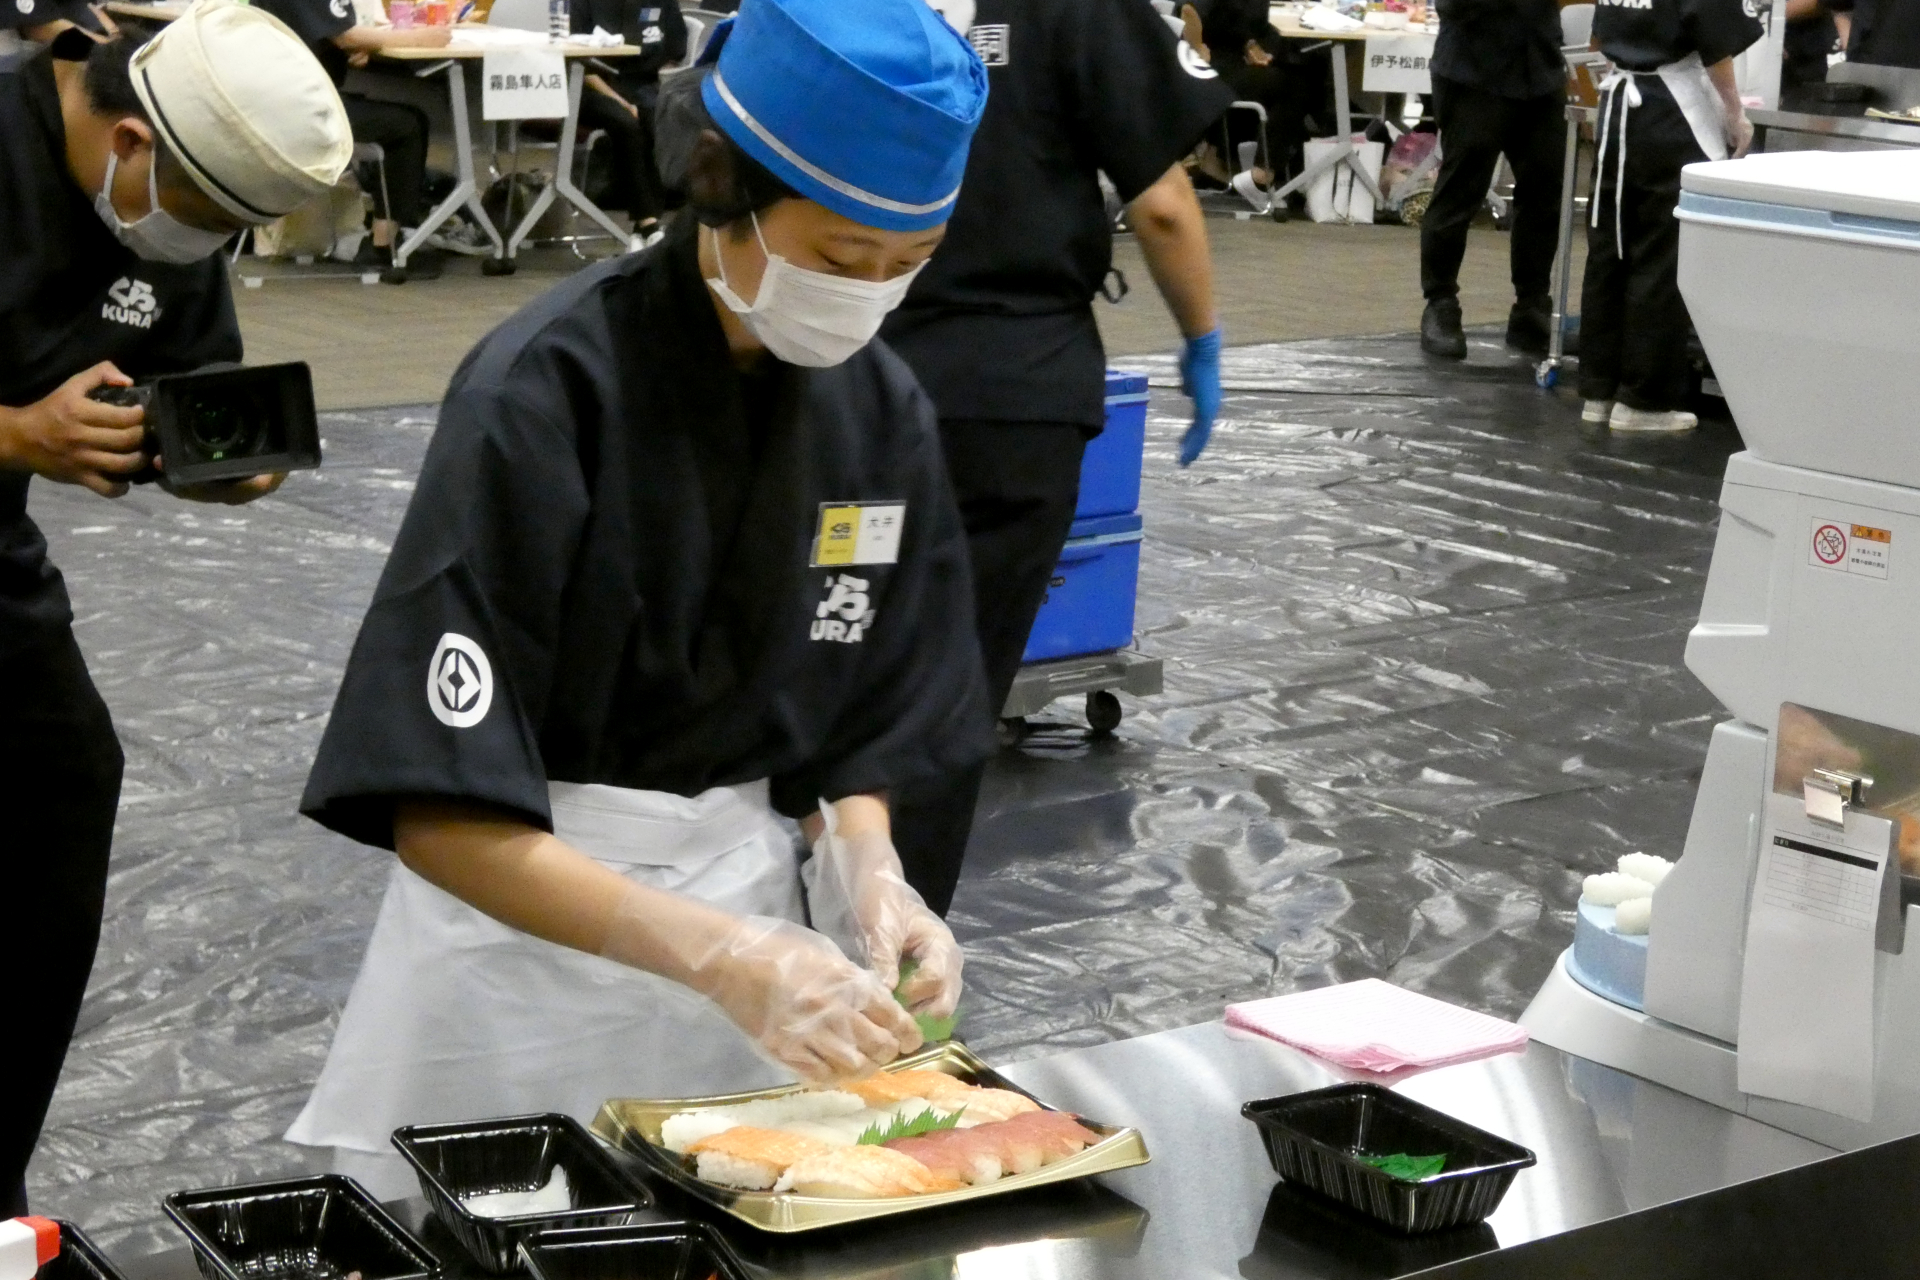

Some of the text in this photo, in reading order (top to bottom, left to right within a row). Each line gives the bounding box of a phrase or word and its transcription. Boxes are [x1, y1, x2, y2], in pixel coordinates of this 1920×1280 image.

[1371, 54, 1431, 70] 伊予松前
[490, 73, 562, 91] 霧島隼人店
[101, 302, 153, 330] KURA
[809, 619, 863, 643] URA
